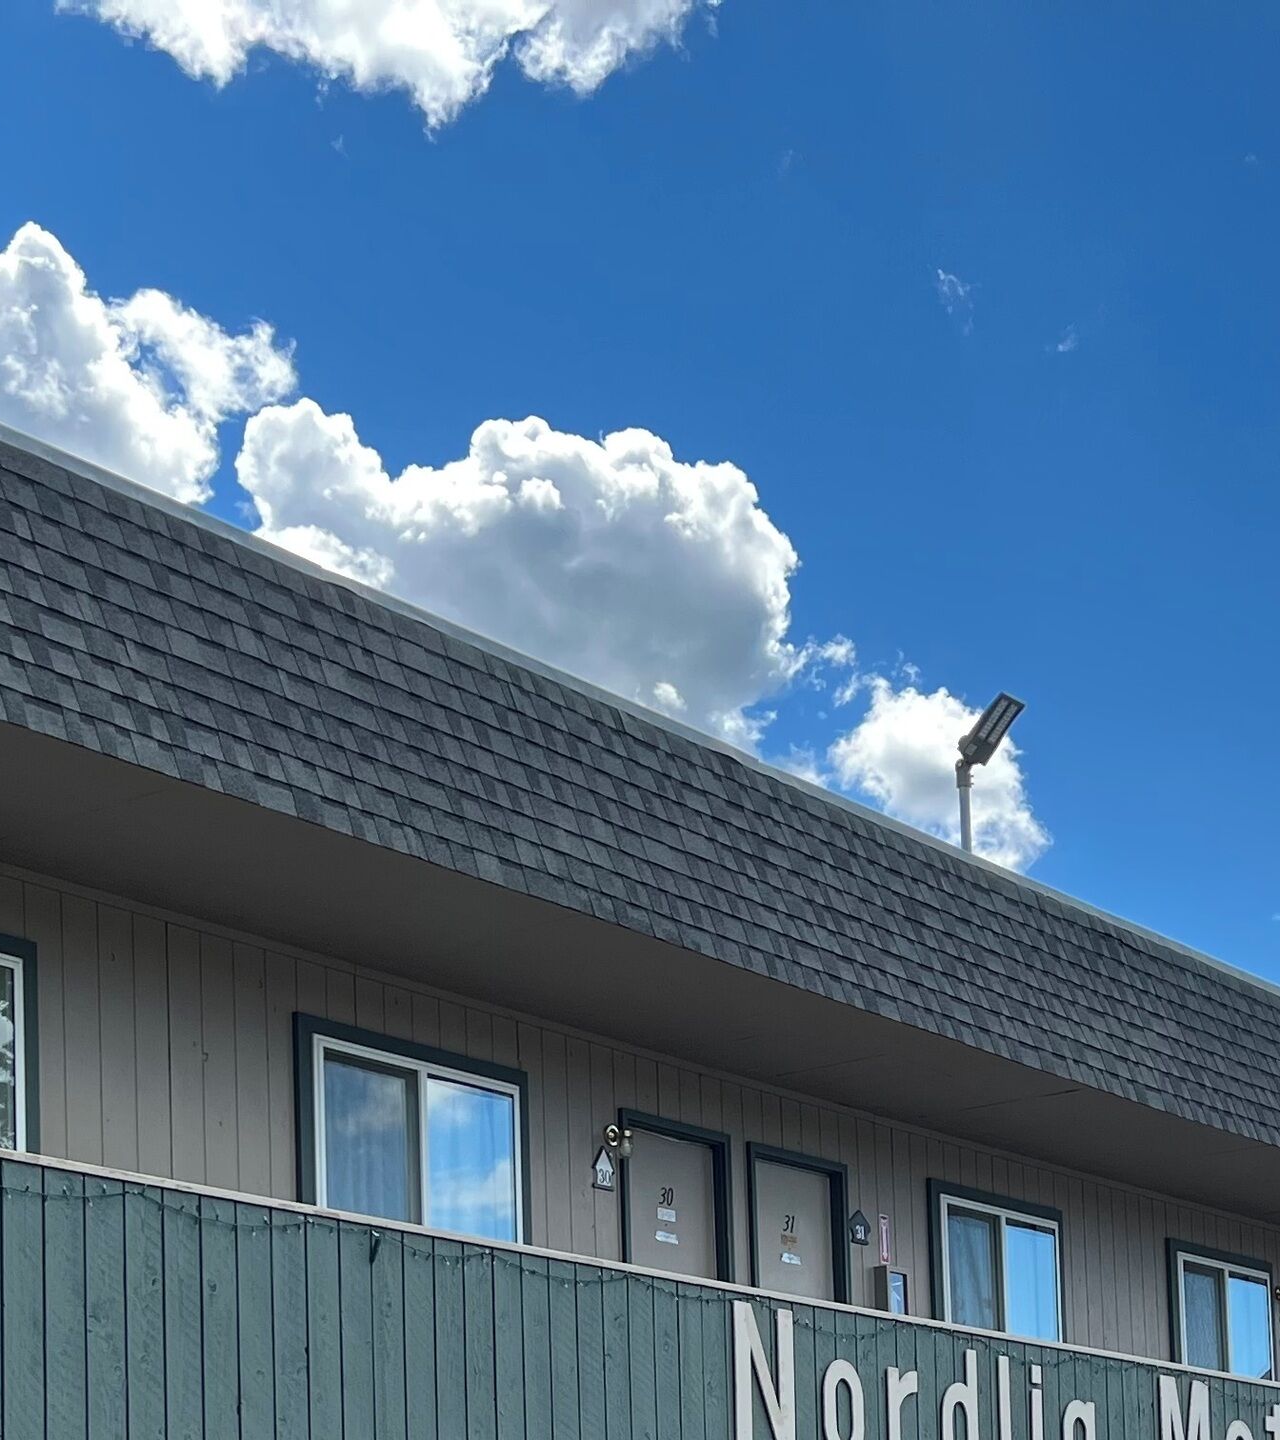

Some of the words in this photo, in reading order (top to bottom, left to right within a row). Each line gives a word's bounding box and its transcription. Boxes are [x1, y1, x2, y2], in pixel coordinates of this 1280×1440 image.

[598, 1168, 611, 1185] 30
[658, 1186, 675, 1207] 30
[782, 1214, 796, 1234] 31
[855, 1224, 866, 1241] 31
